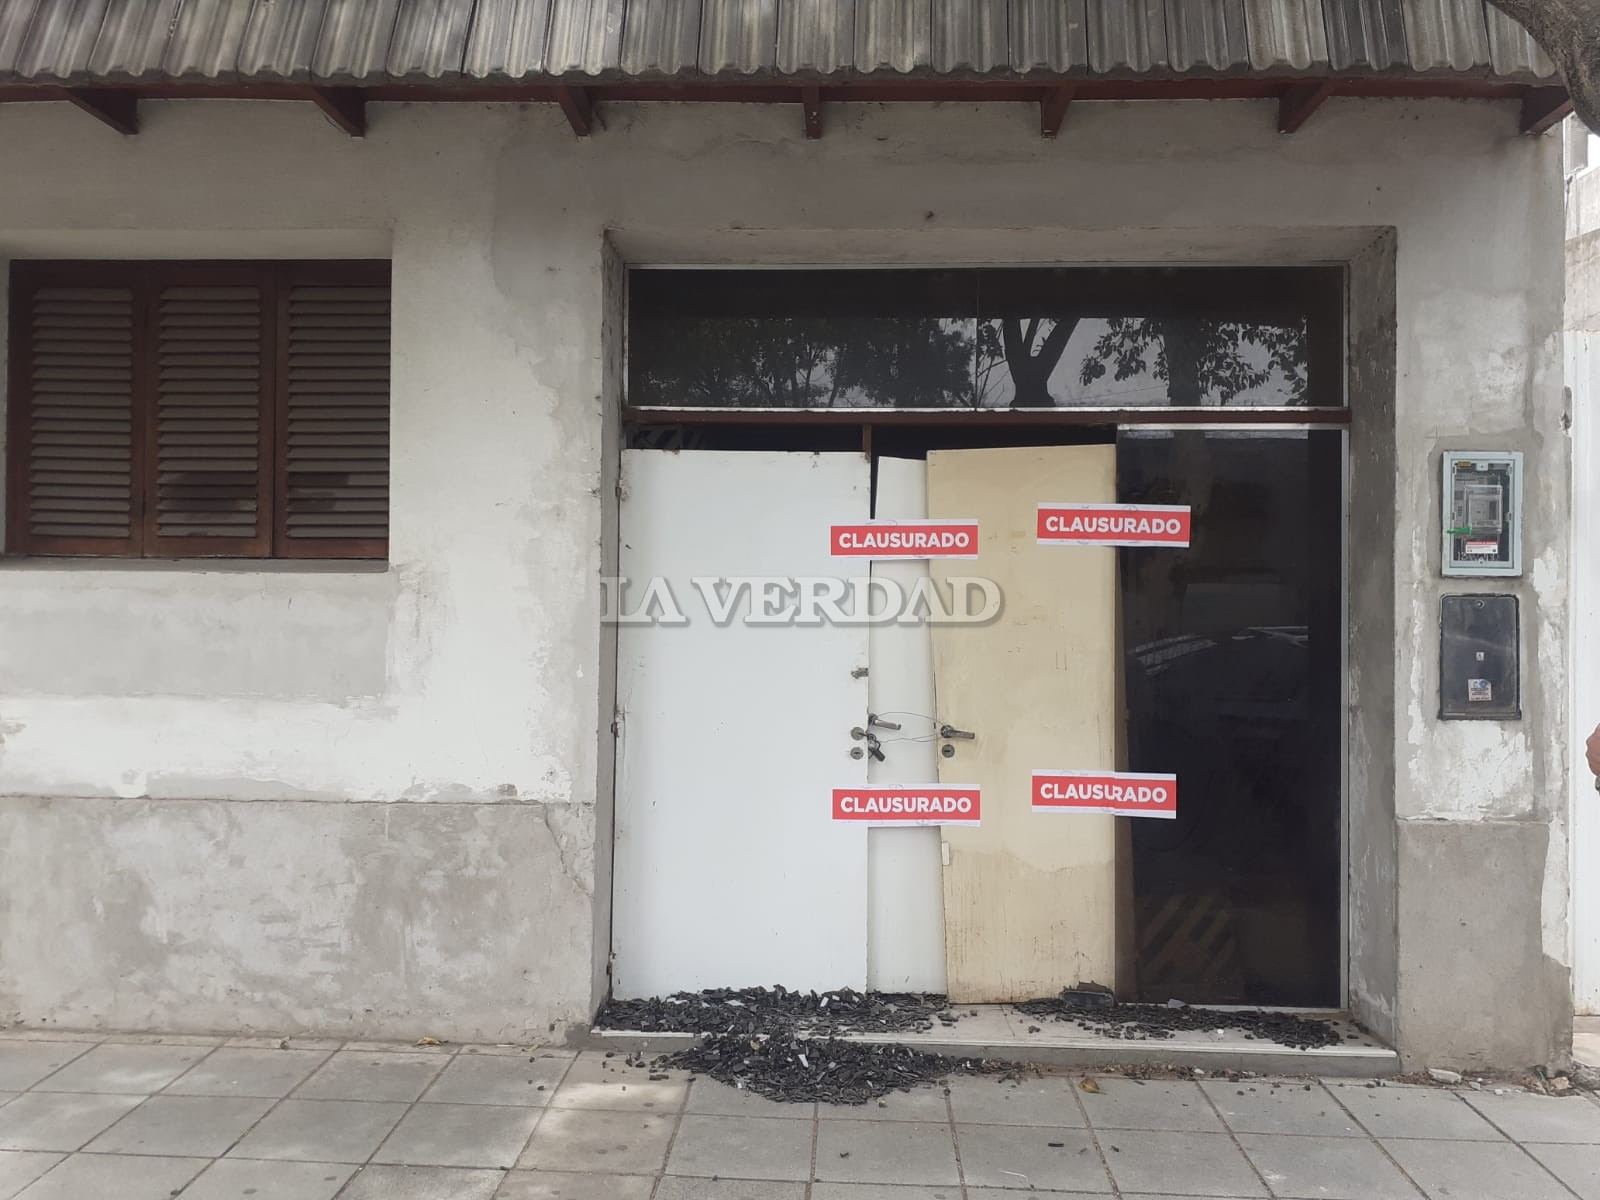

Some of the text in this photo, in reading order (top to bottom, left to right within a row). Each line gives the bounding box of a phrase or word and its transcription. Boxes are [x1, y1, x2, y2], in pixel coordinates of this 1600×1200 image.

[1045, 516, 1181, 535] CLAUSURADO
[838, 532, 970, 549] CLAUSURADO
[1040, 783, 1167, 804] CLAUSURADO
[840, 796, 972, 813] CLAUSURADO
